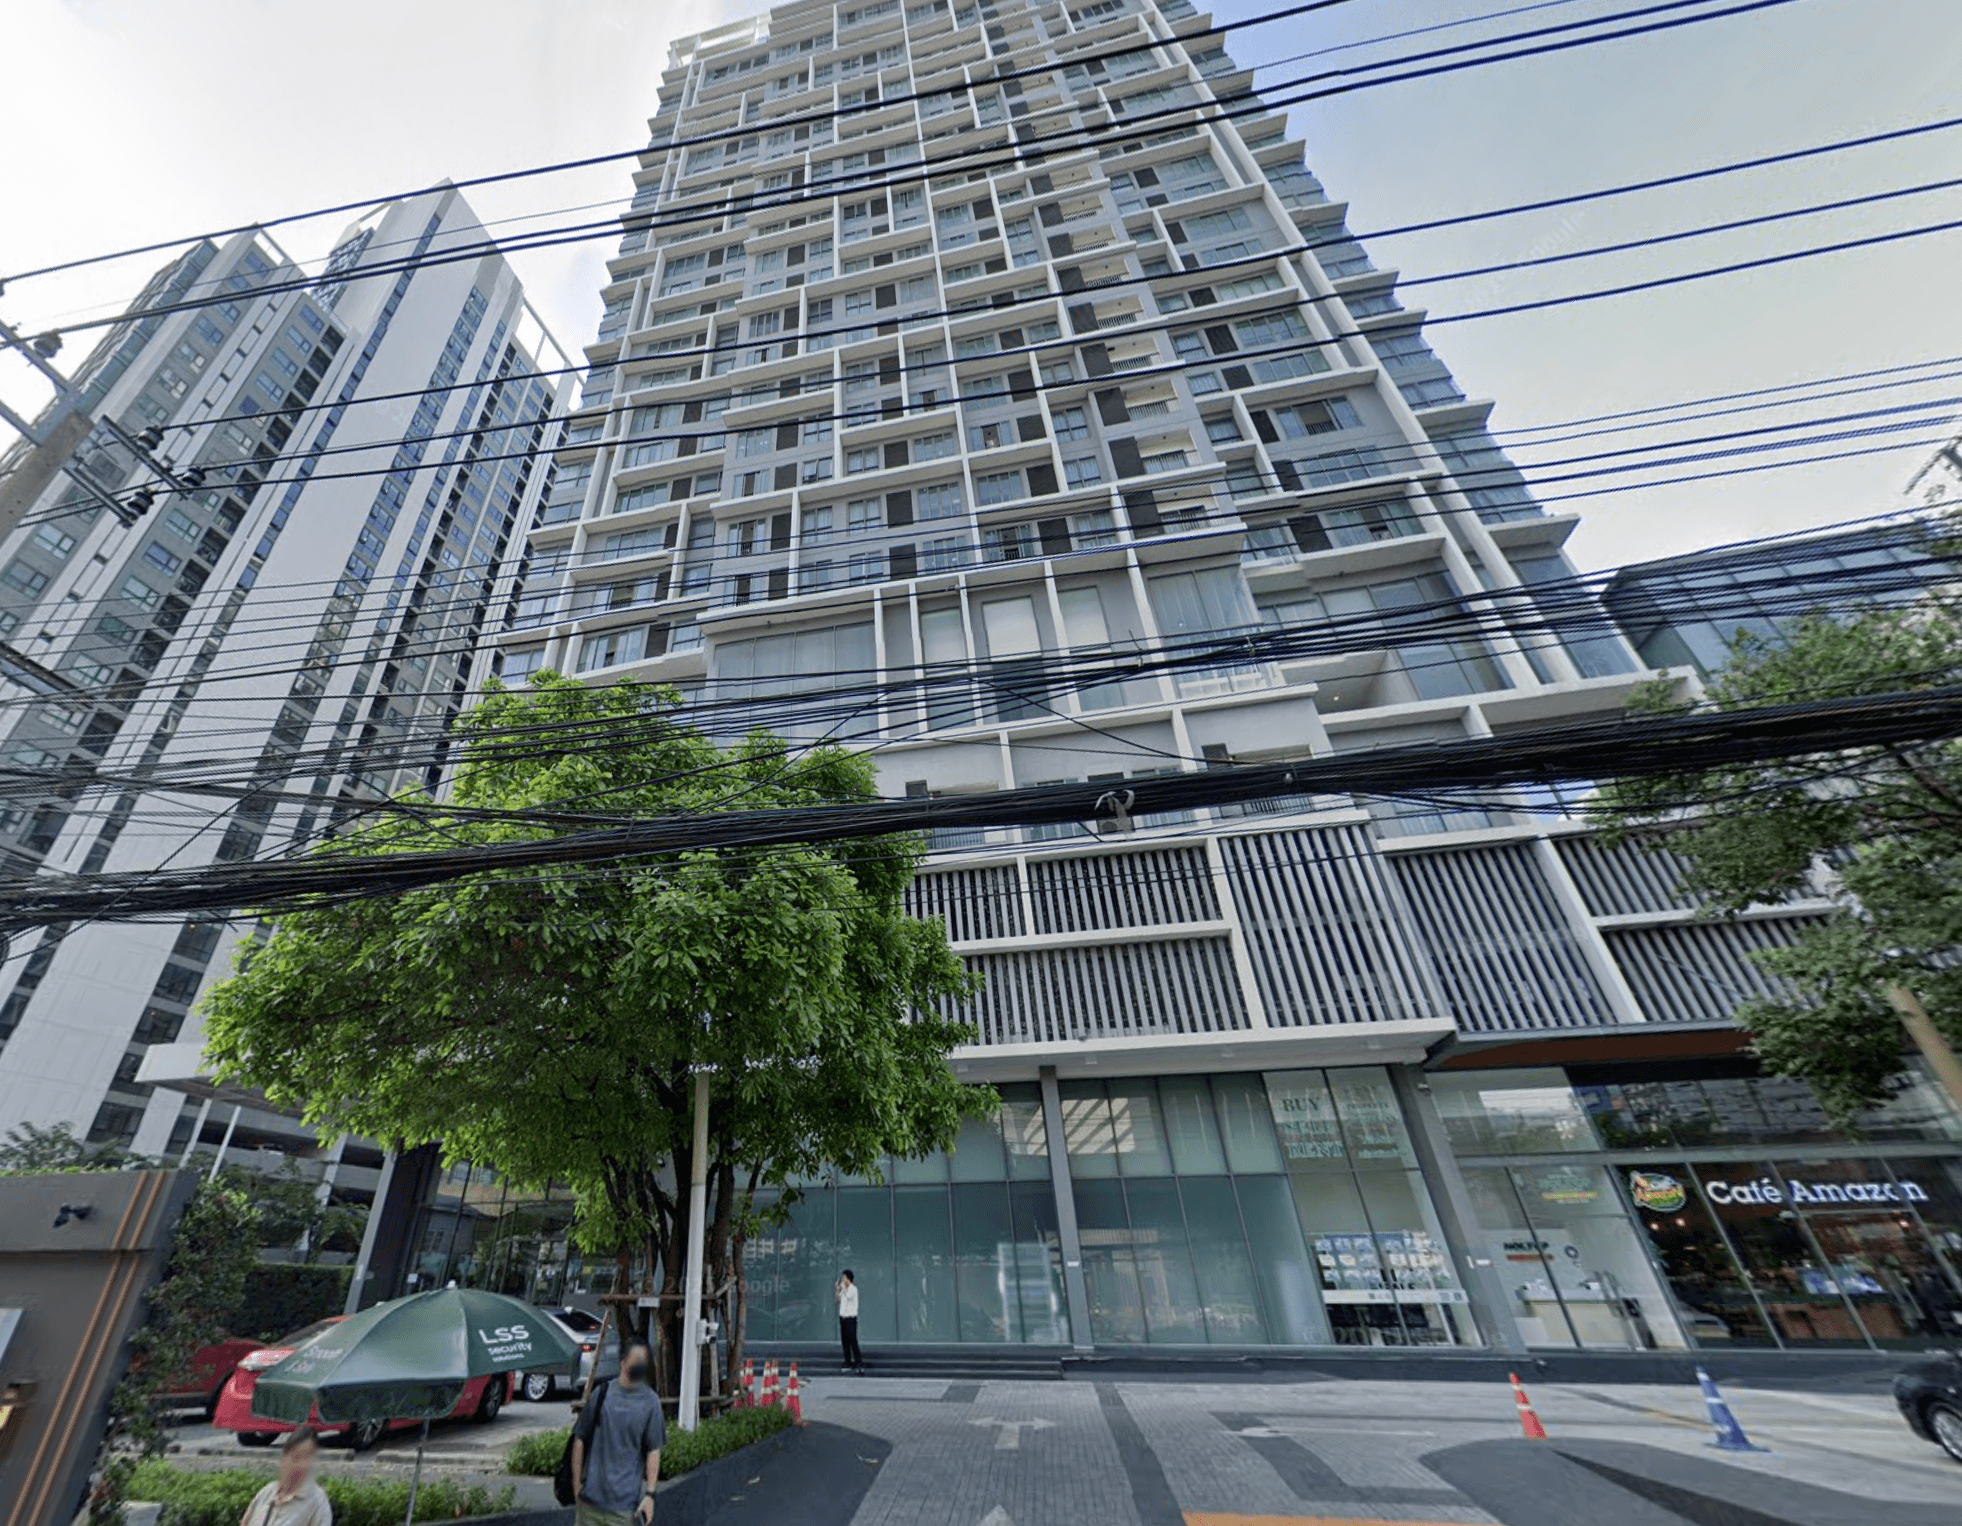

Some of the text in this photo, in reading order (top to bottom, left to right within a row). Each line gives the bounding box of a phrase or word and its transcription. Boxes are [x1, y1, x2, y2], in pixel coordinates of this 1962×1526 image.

[1282, 1096, 1320, 1112] BUY
[1706, 1177, 1783, 1204] Café
[478, 1324, 530, 1344] LSS
[487, 1342, 532, 1355] security
